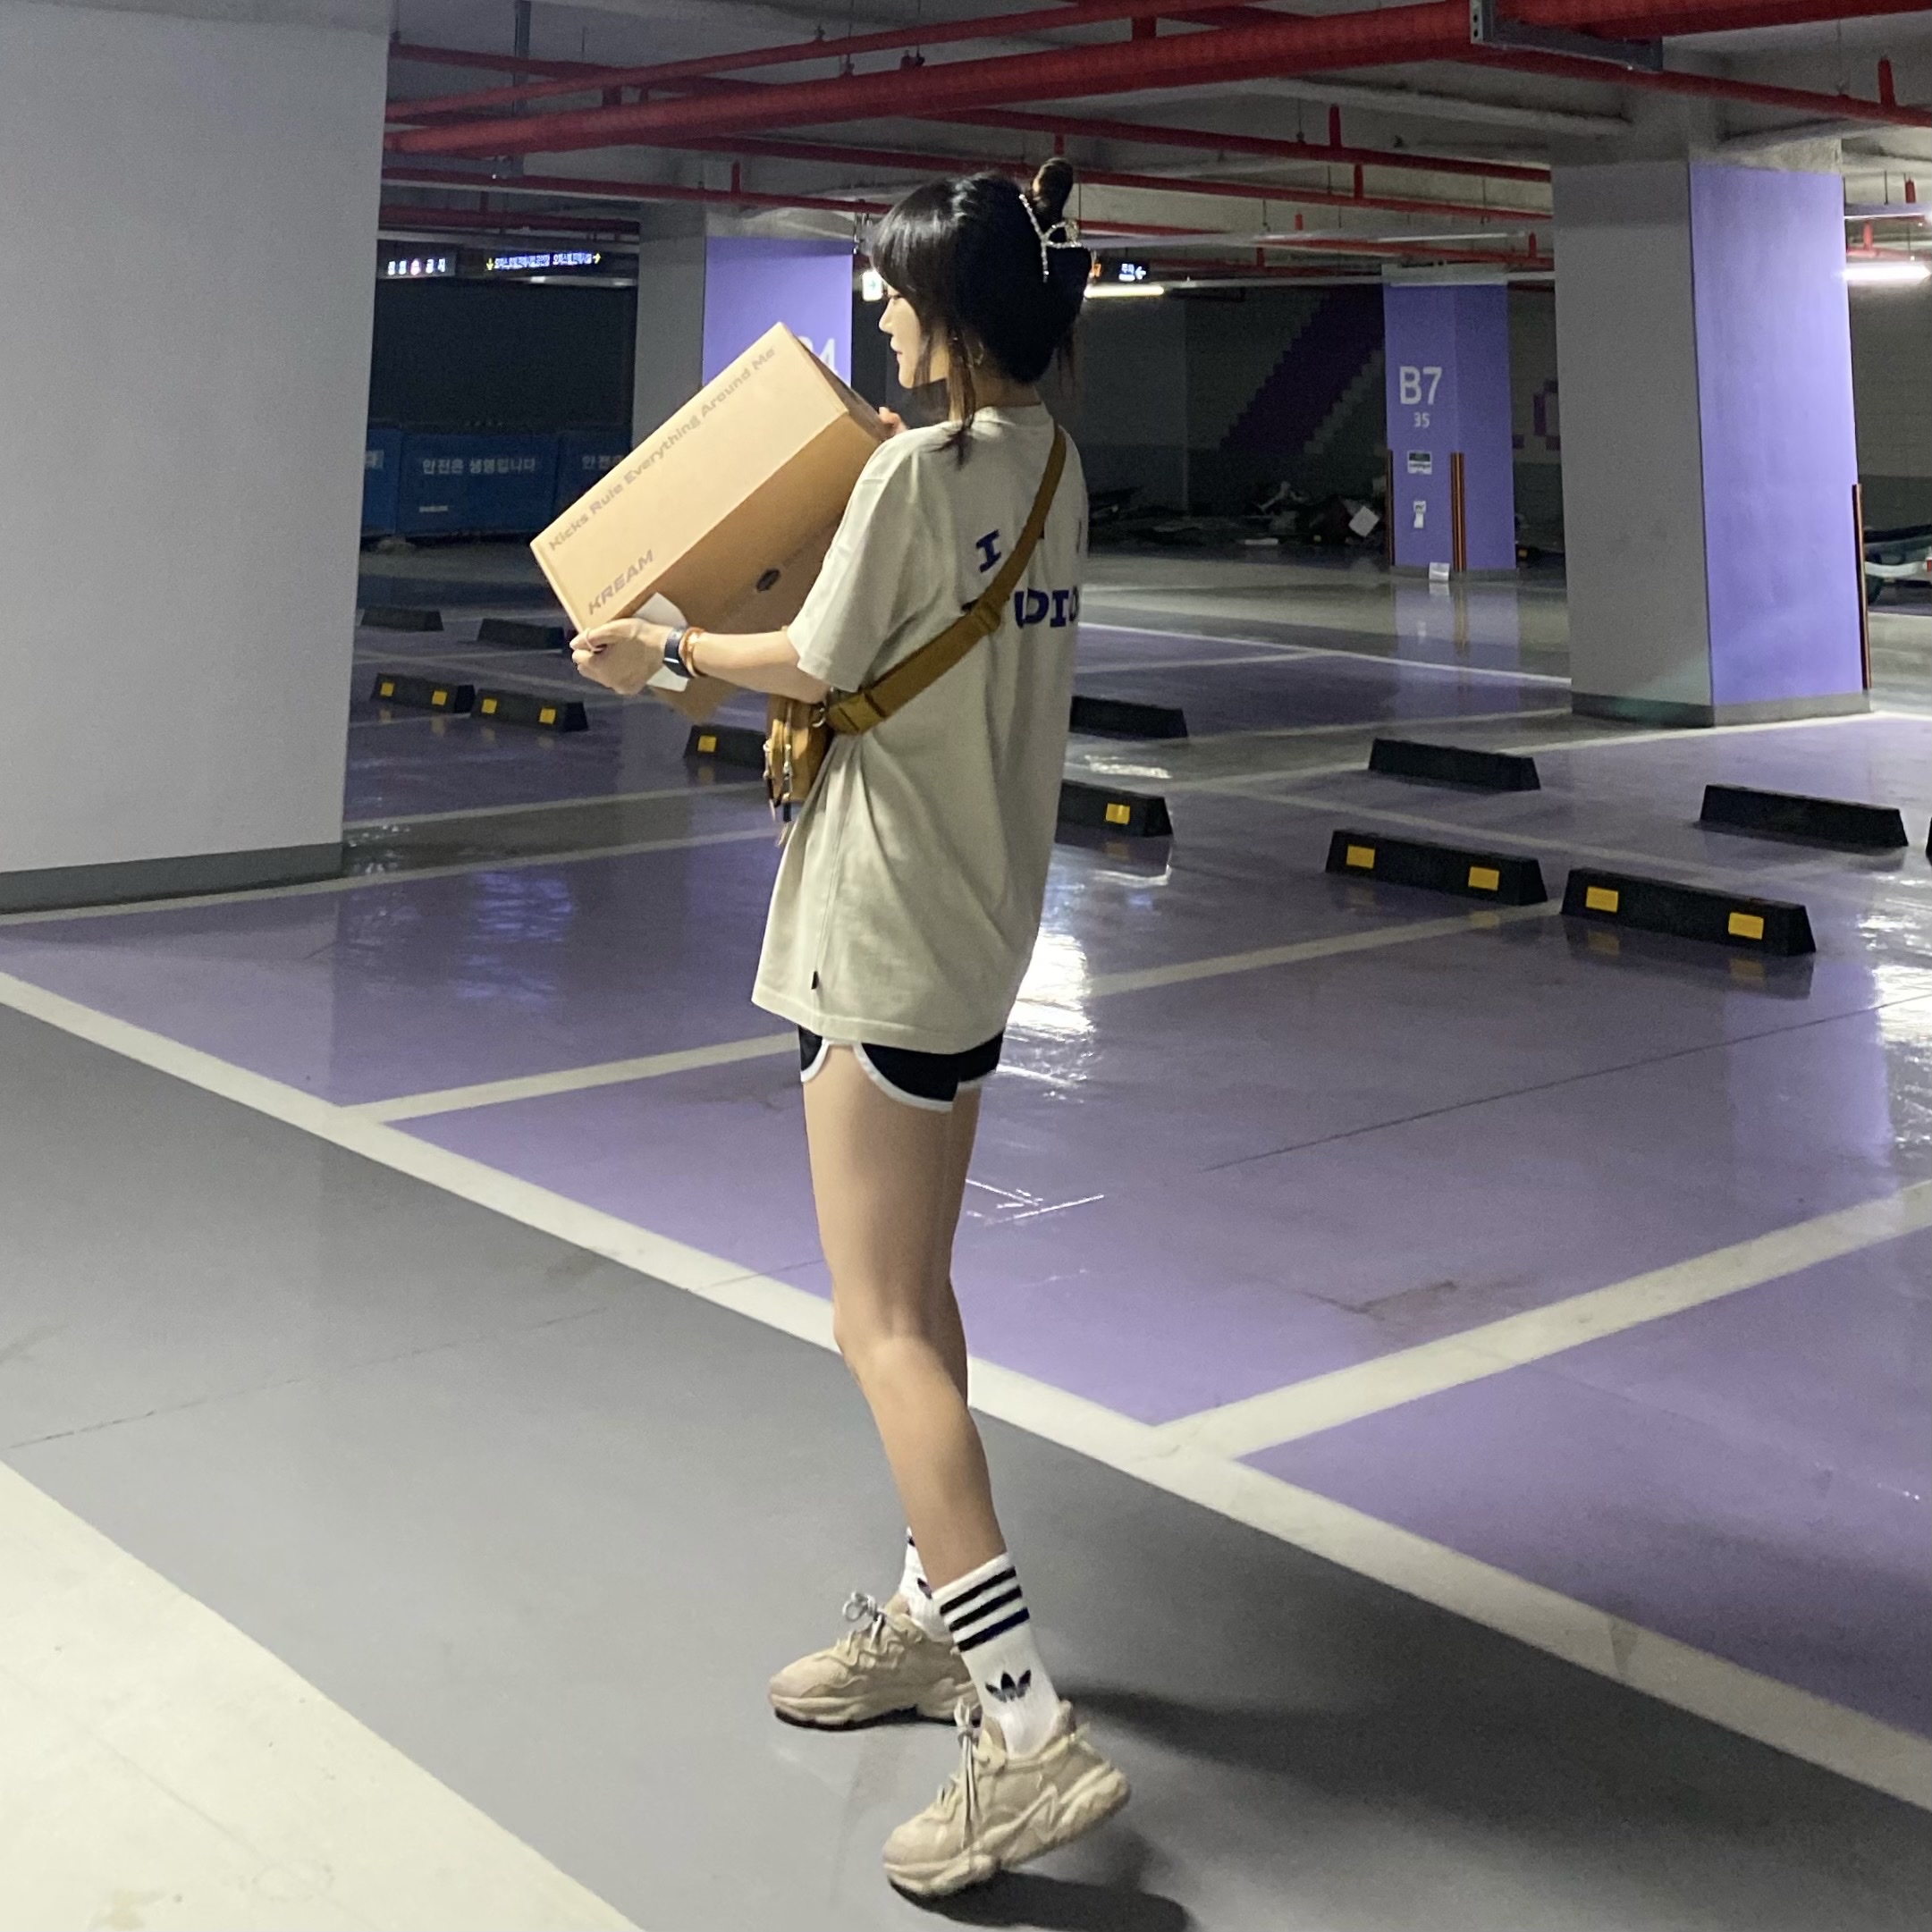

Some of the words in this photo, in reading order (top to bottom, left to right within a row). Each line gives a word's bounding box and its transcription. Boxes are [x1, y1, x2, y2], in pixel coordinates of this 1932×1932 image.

[1398, 365, 1443, 406] B7
[548, 512, 589, 552] Kicks
[588, 483, 624, 516] Rule
[623, 414, 702, 485] Everything
[700, 367, 752, 418] Around
[751, 346, 776, 372] Me
[587, 548, 654, 616] KREAM
